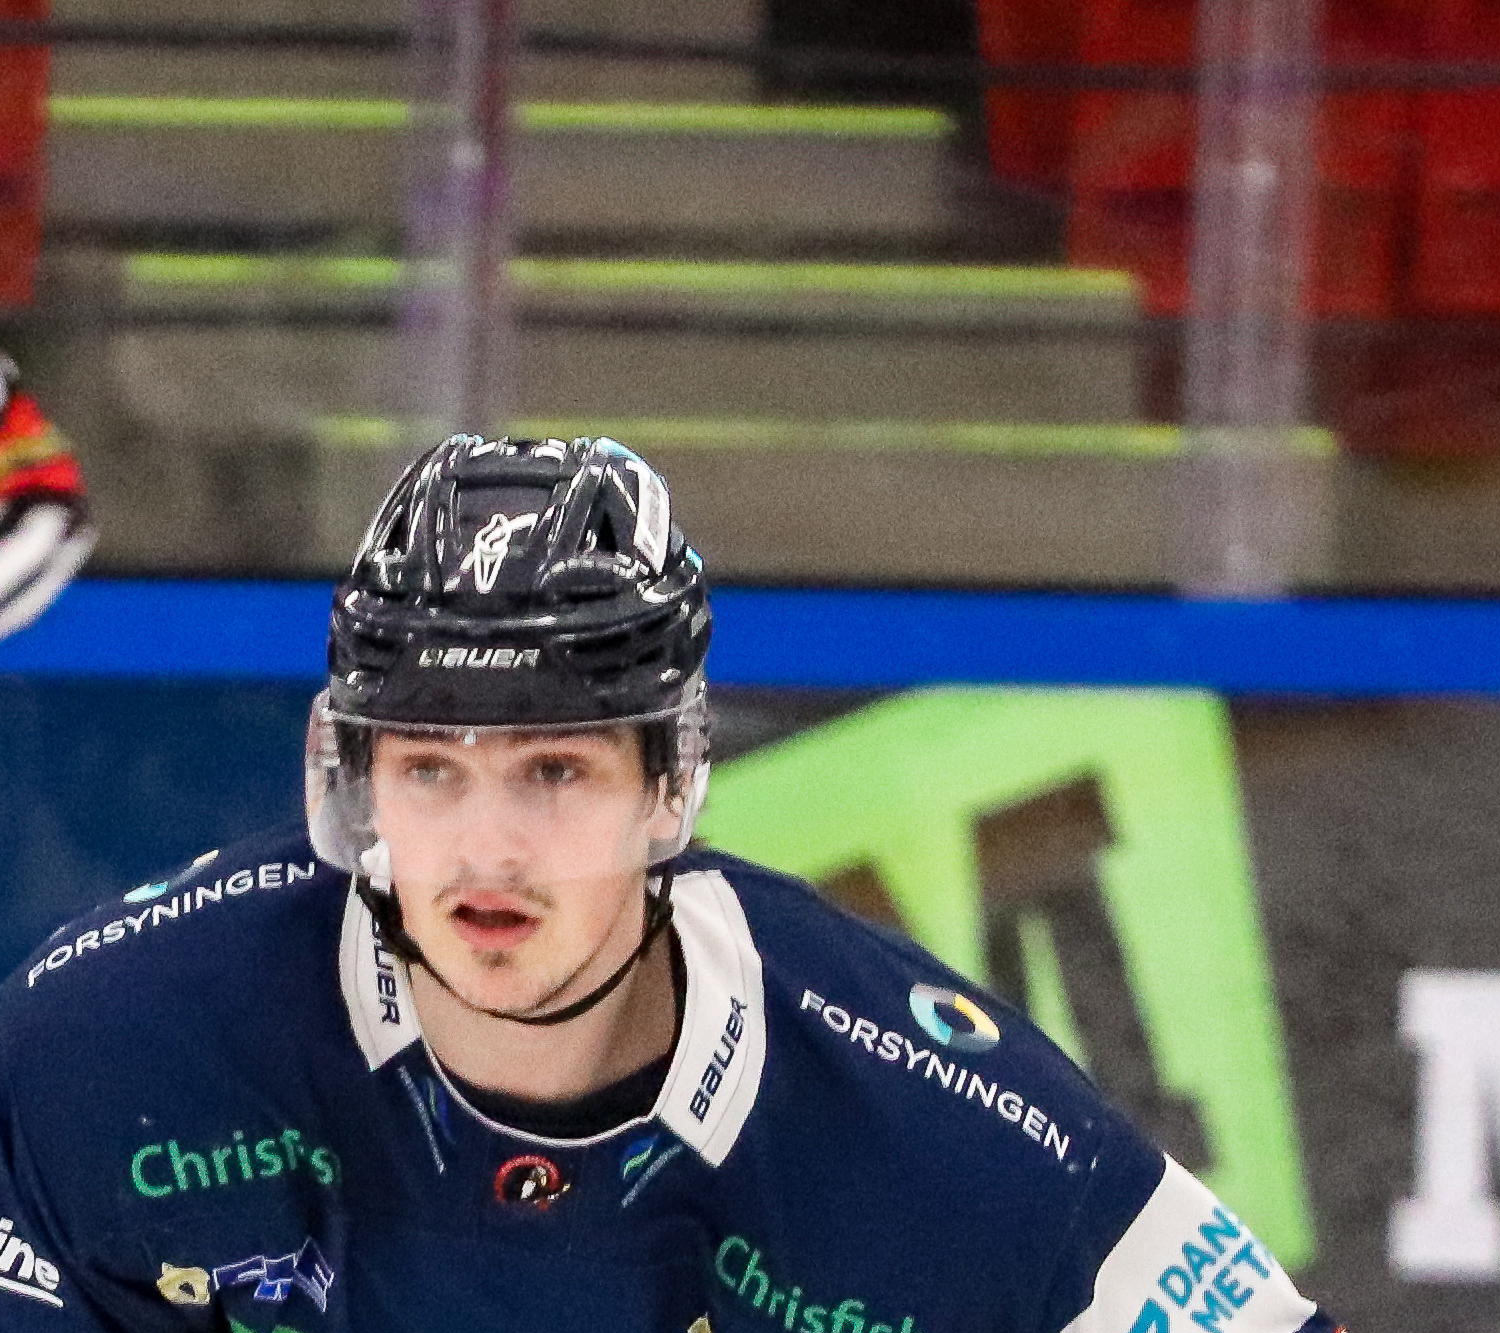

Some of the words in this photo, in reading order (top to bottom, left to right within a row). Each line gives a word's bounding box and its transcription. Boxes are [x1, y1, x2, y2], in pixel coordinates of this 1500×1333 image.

[26, 861, 316, 988] FORSYNINGEN
[690, 995, 747, 1123] BAUER
[800, 988, 1070, 1161] FORSYNINGEN
[1157, 1204, 1246, 1309] DAN
